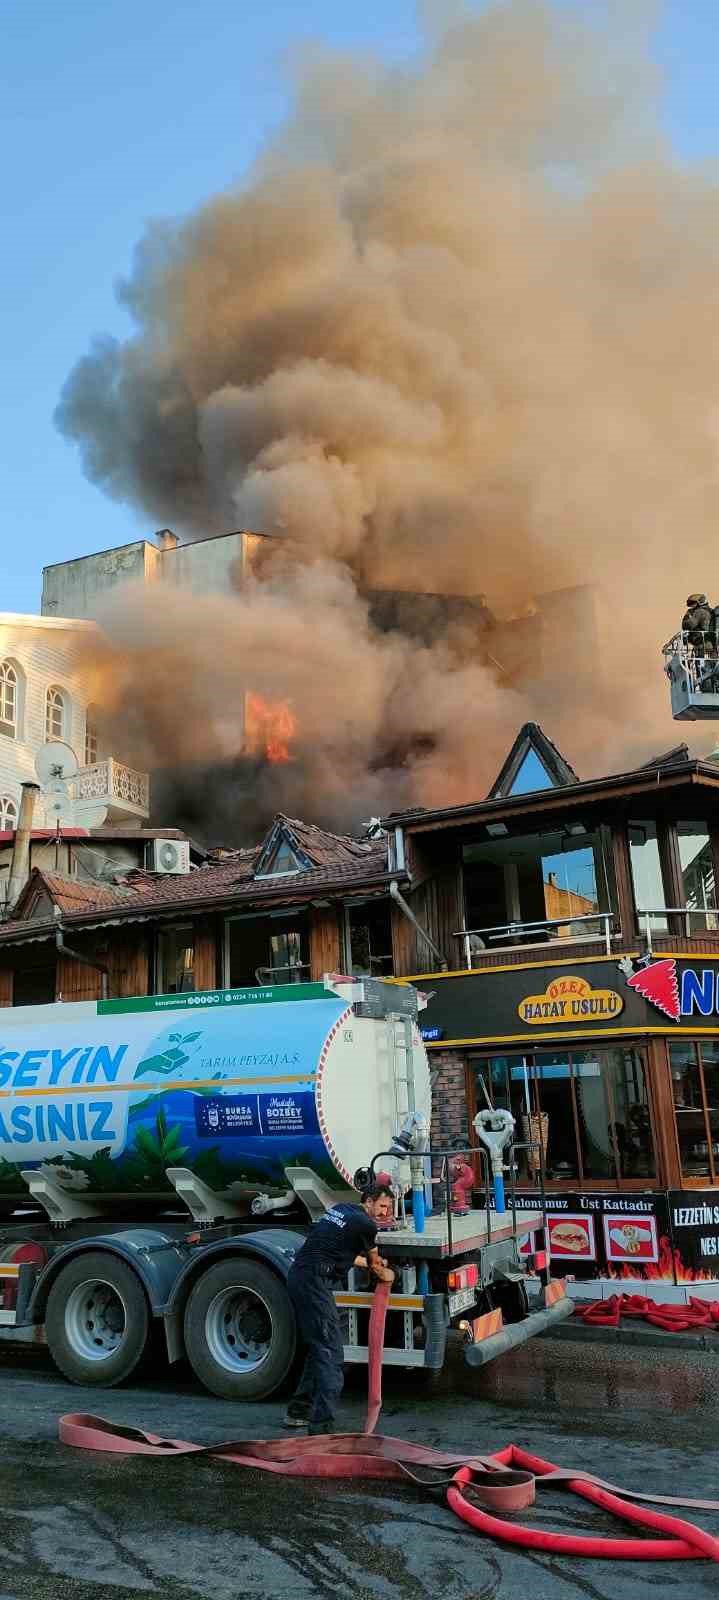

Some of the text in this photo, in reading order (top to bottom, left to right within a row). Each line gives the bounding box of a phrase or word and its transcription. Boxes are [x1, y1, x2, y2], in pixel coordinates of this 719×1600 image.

[549, 981, 588, 998] ÖZEL
[681, 969, 719, 1015] N
[523, 993, 618, 1020] HATAY USULÜ
[225, 1106, 252, 1115] BURSA
[266, 1107, 302, 1117] BOZBEY
[580, 1196, 601, 1210] Üst
[603, 1199, 655, 1211] Kattadır
